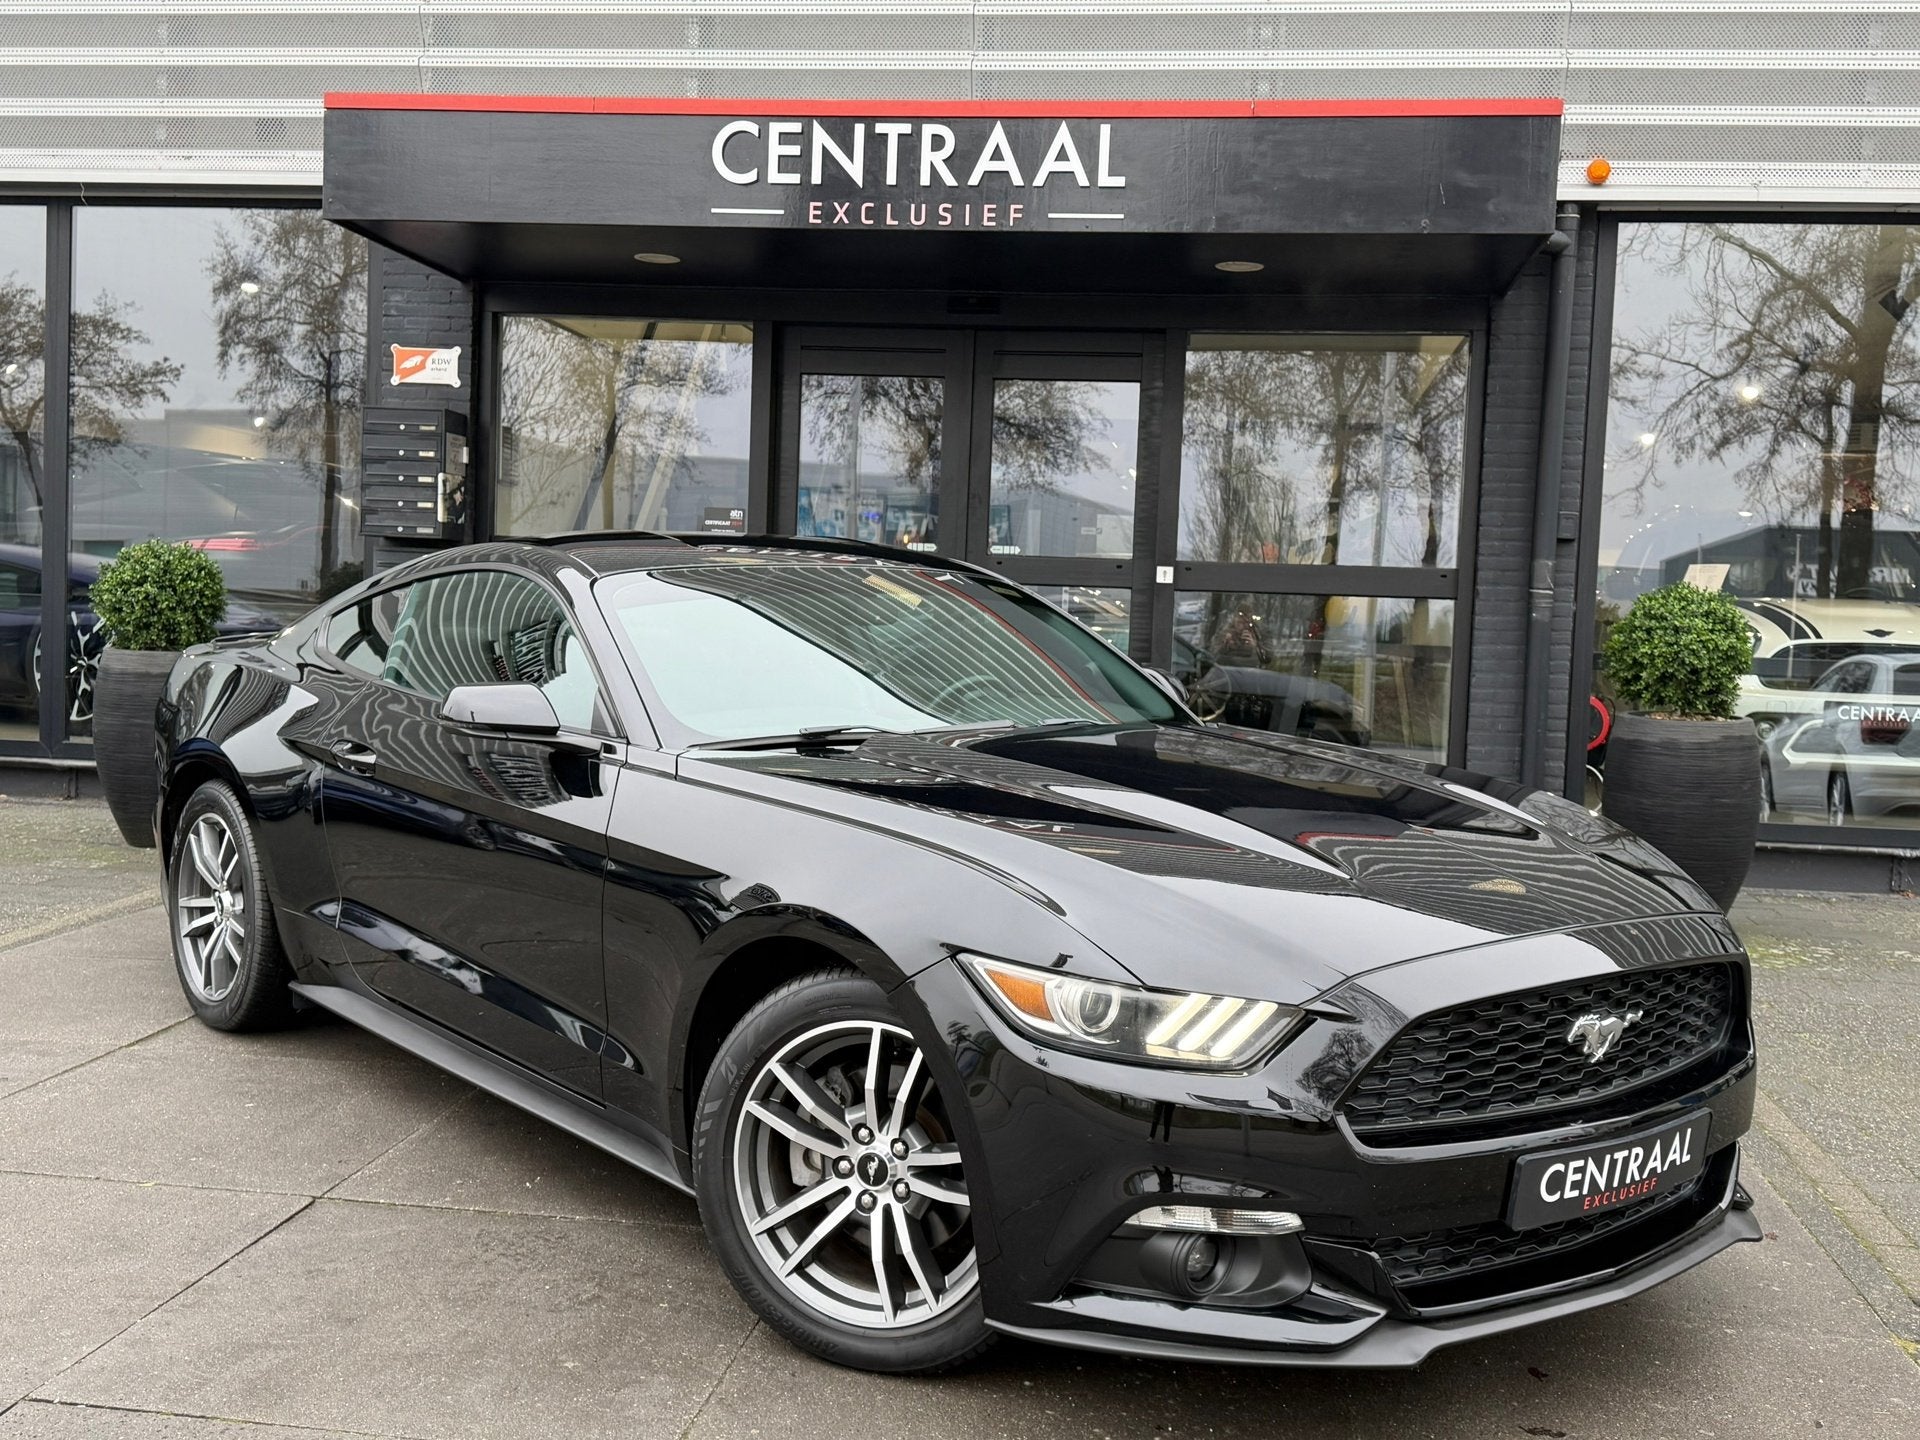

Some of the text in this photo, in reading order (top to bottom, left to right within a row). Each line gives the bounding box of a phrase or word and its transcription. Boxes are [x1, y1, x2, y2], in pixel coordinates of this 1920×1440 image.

[711, 119, 1126, 188] CENTRAAL
[808, 202, 1024, 226] EXCLUSIEF
[1540, 1128, 1692, 1203] CENTRAAL
[1583, 1177, 1658, 1210] EXCLUSIEF
